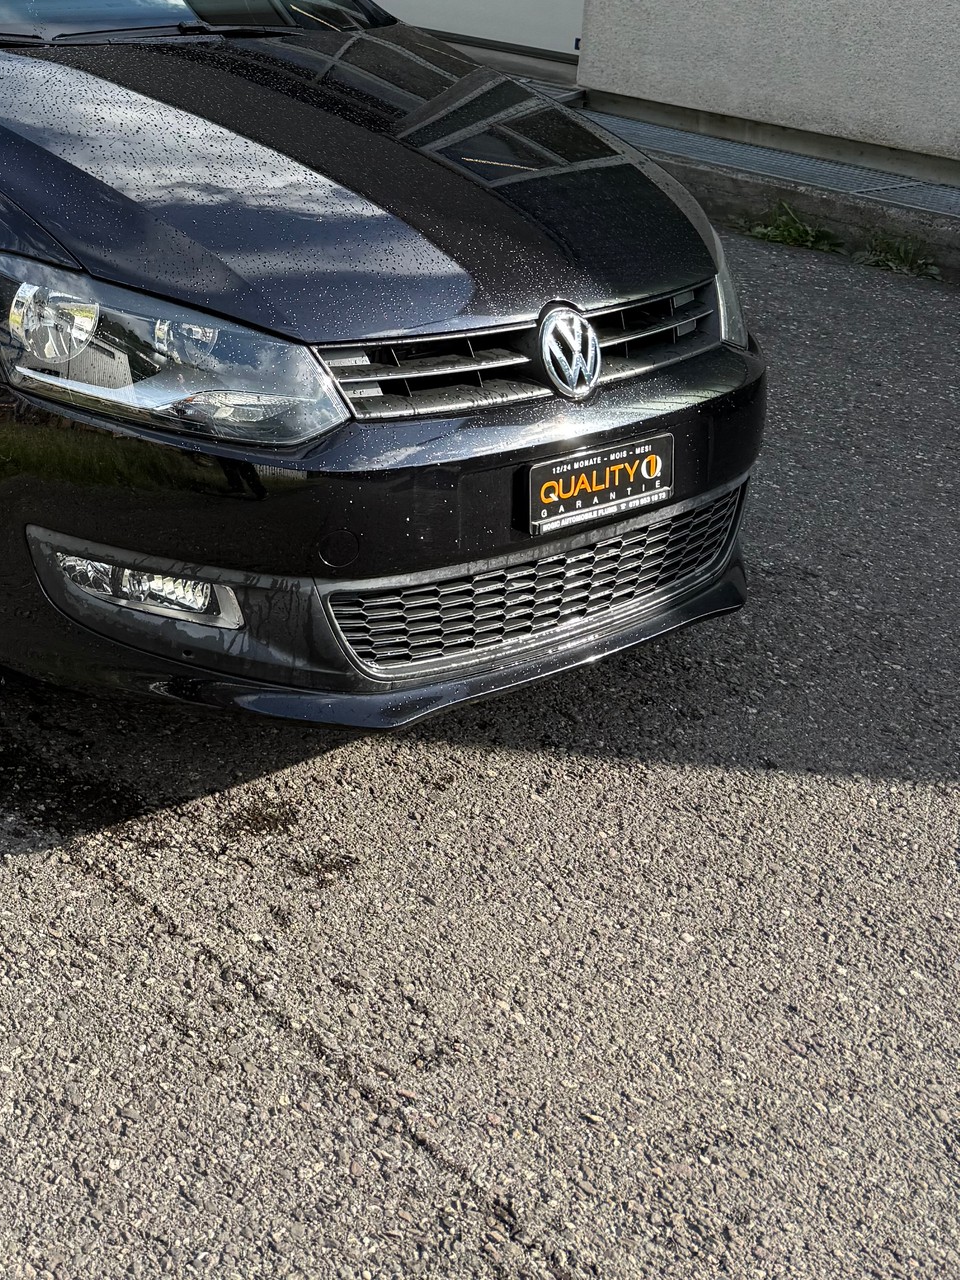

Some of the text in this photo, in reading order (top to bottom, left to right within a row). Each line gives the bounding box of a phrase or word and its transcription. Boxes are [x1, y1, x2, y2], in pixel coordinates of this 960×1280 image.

[552, 464, 571, 474] 12/24
[573, 456, 602, 469] MONATE
[609, 450, 627, 461] MOIS
[635, 444, 652, 454] MESI
[540, 459, 640, 504] QUALITY
[541, 479, 661, 518] GARANTIE
